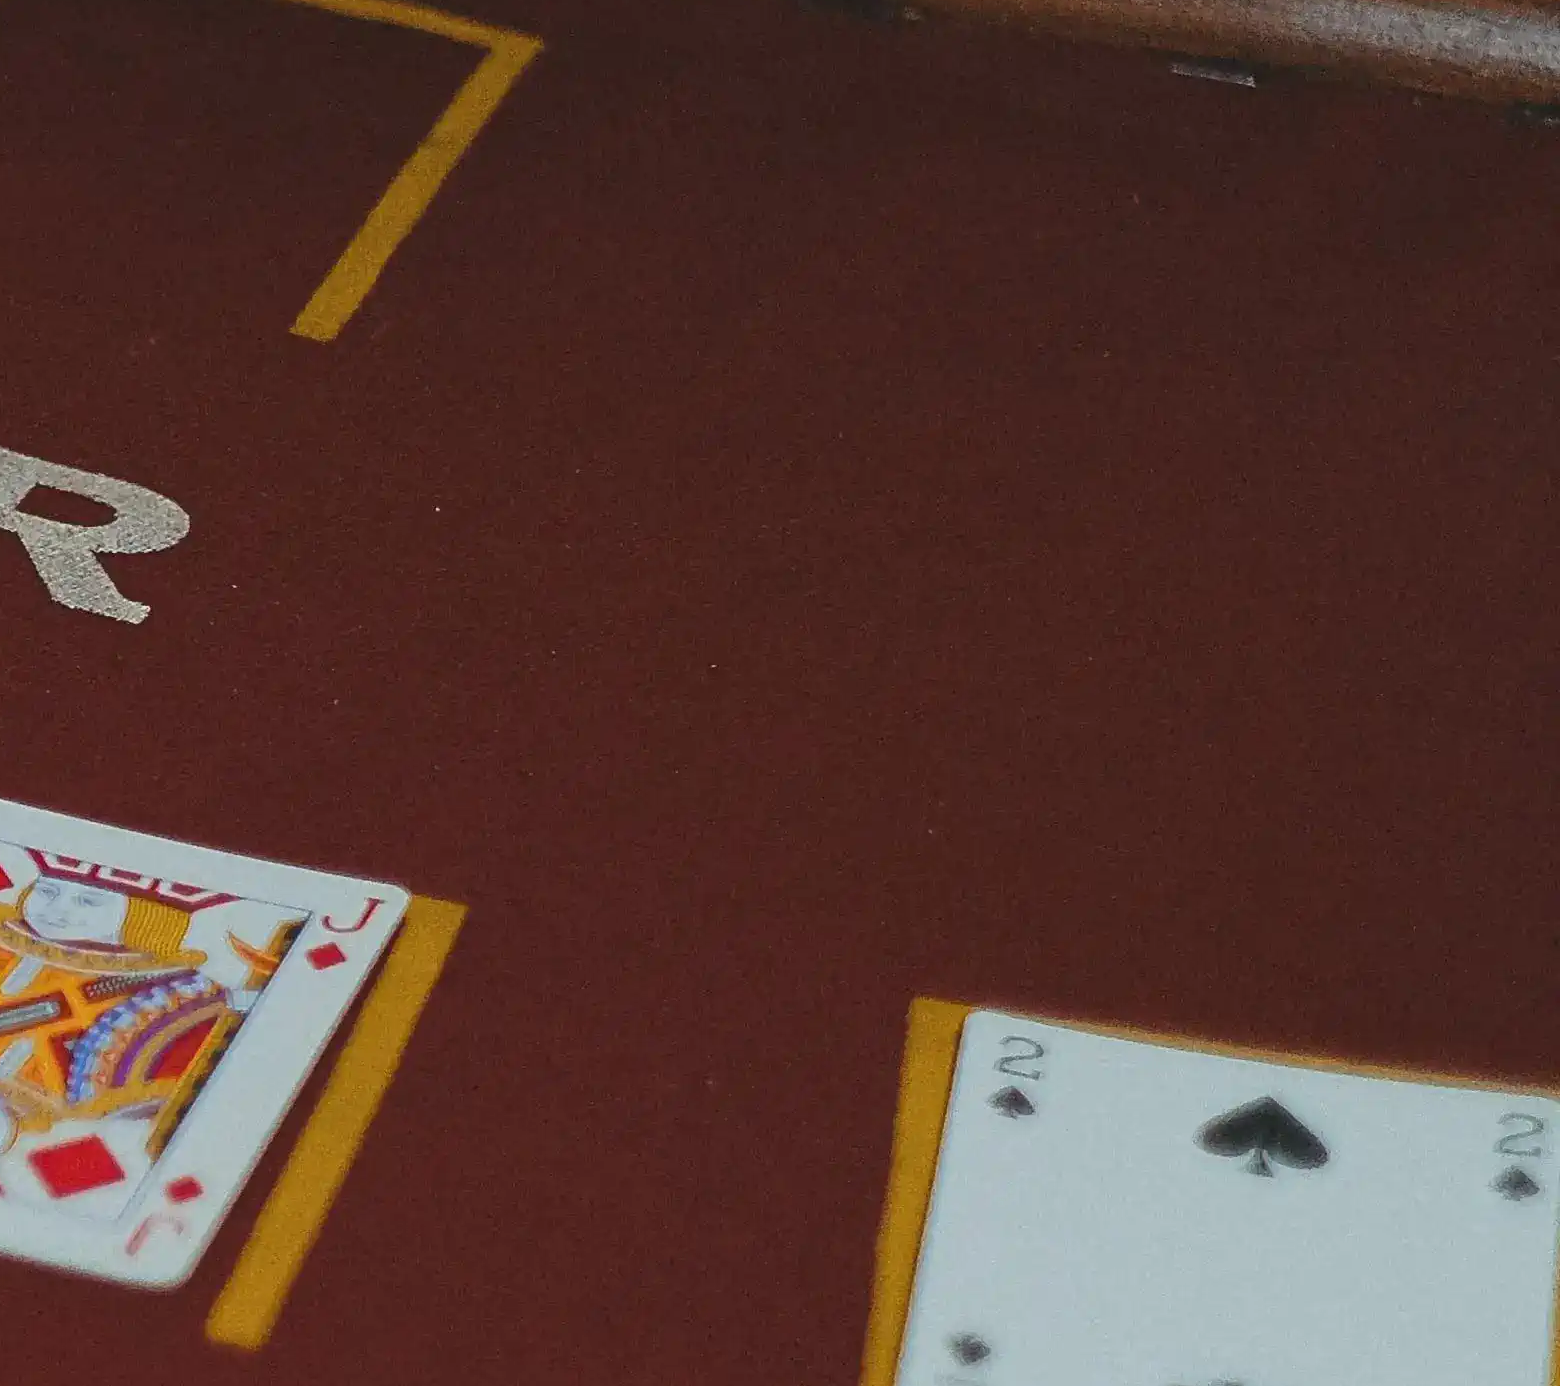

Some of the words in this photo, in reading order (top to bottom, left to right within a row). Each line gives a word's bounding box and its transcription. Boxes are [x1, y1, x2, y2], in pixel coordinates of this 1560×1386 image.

[320, 896, 387, 934] J
[993, 1035, 1046, 1082] 2
[1493, 1112, 1546, 1159] 2
